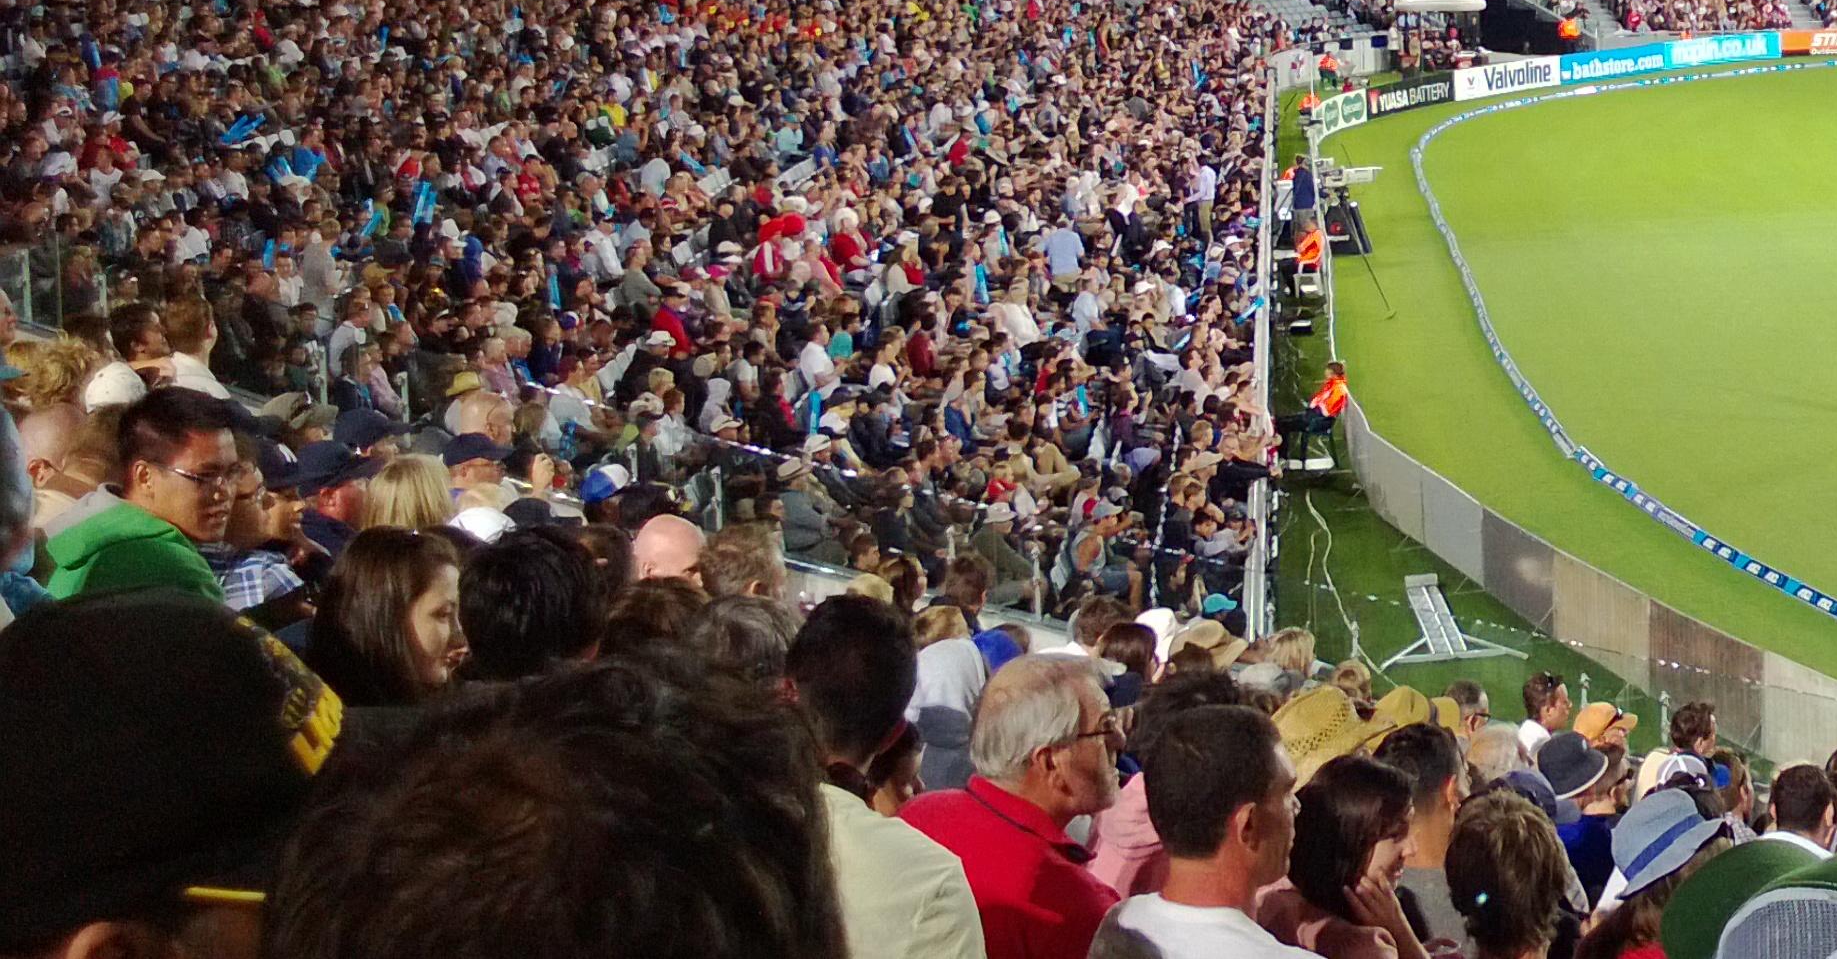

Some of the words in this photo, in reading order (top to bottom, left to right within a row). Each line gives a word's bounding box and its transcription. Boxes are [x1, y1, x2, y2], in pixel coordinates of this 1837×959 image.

[1484, 60, 1552, 91] Valvoline
[1572, 53, 1665, 77] bathstore.com
[1381, 89, 1409, 111] YUASA
[1409, 82, 1451, 104] BATTERY
